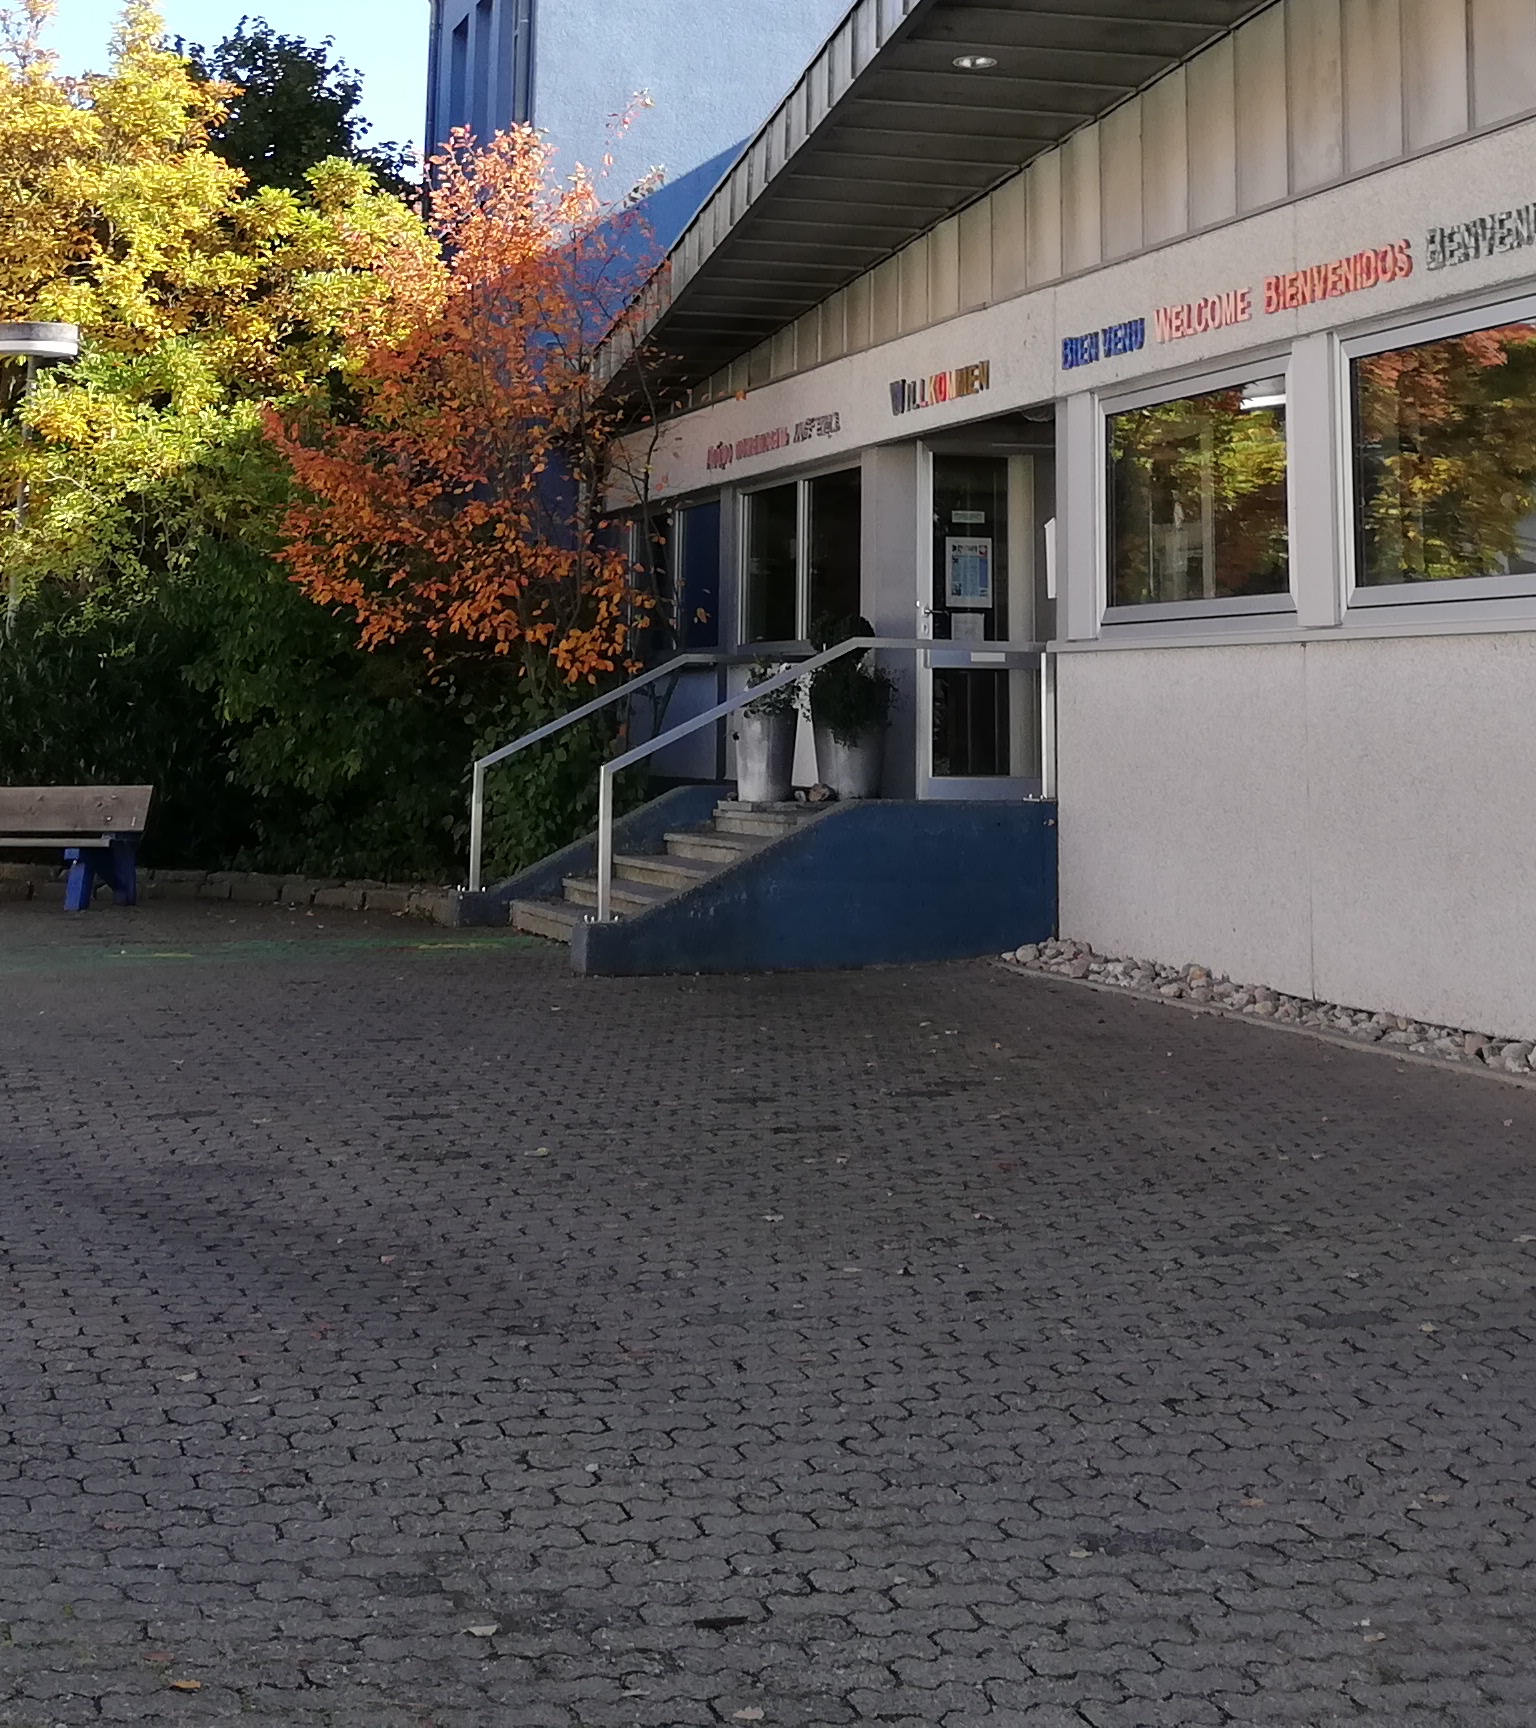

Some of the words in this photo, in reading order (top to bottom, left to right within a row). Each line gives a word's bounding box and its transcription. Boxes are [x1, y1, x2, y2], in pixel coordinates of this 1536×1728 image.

[1263, 238, 1414, 315] BIENVENIDOS
[1061, 331, 1100, 371] BIEN
[1101, 317, 1146, 359] VENU
[1153, 286, 1253, 344] WELCOME
